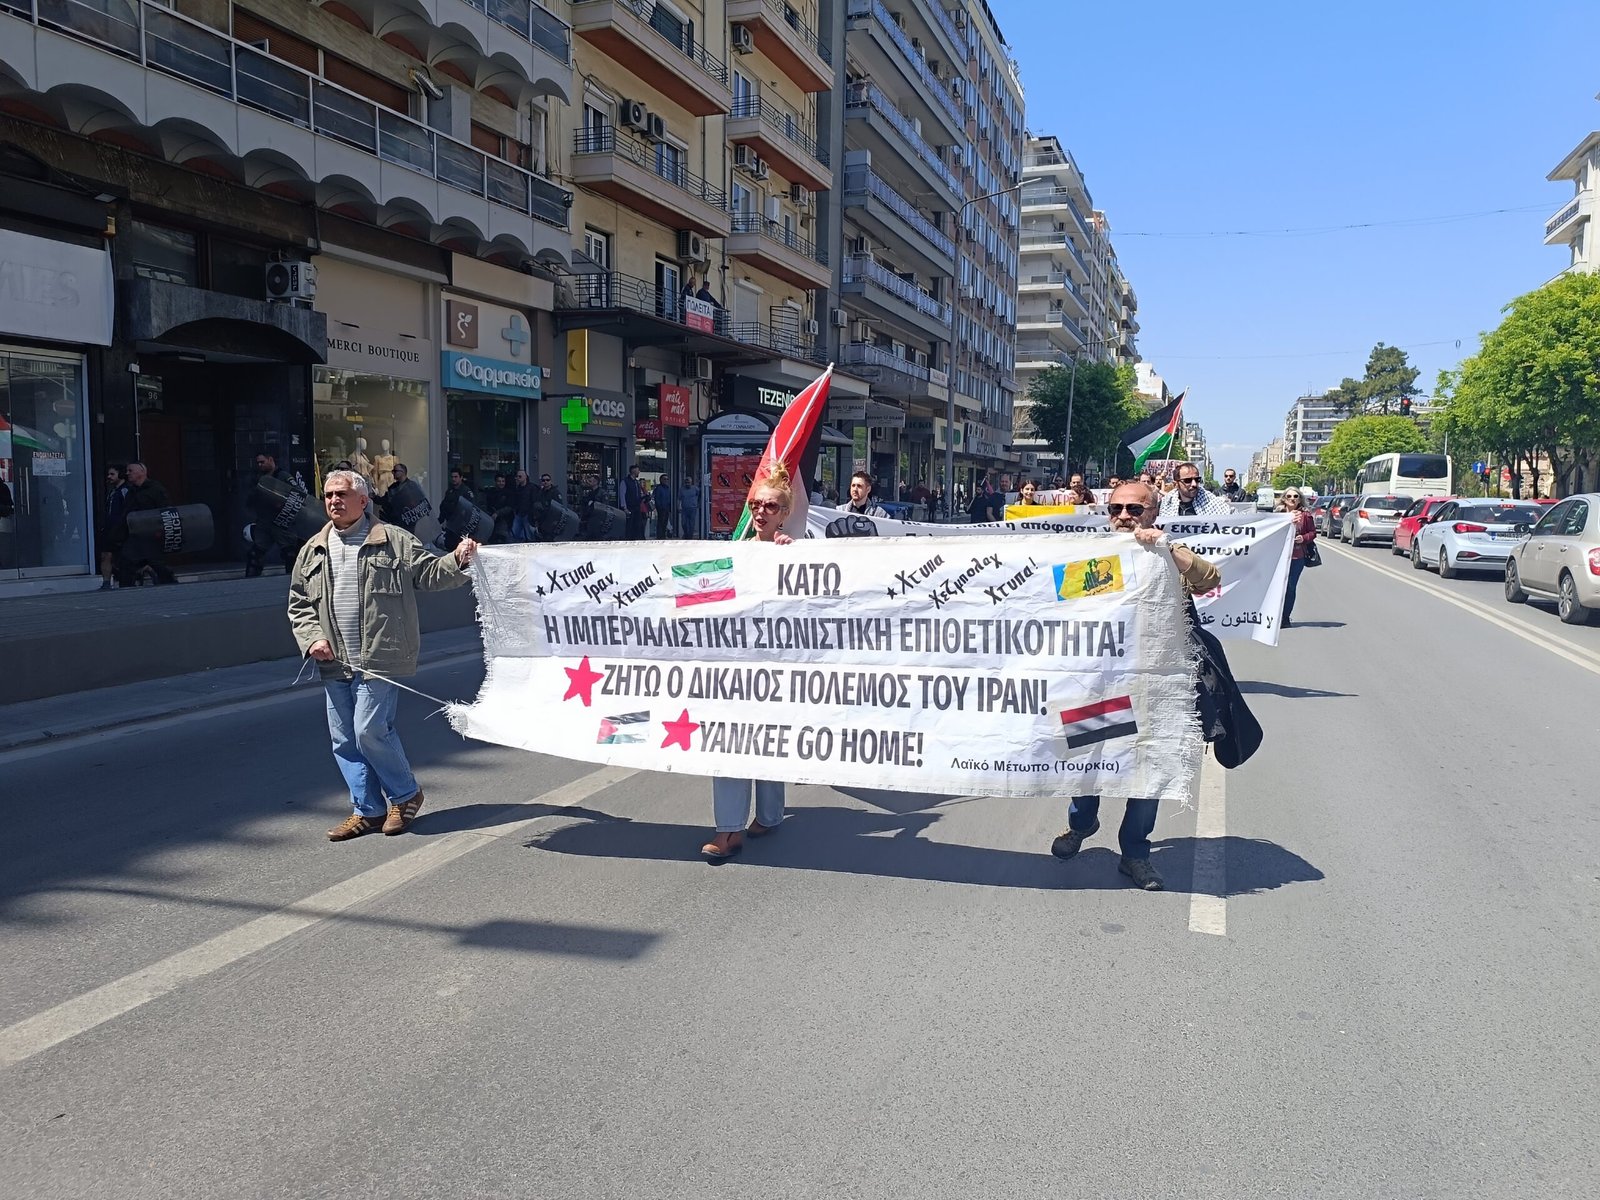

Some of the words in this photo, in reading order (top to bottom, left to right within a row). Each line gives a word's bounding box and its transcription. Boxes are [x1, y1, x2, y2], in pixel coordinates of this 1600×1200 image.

[327, 338, 362, 353] MERCI
[368, 345, 420, 363] BOUTIQUE
[455, 357, 540, 389] Φαρμακείο
[148, 391, 158, 400] 96
[542, 427, 551, 436] 96
[281, 496, 305, 528] POLICE
[170, 511, 182, 550] POLICE
[1020, 520, 1098, 534] απόφαση
[1170, 522, 1256, 538] εκτέλεση
[546, 561, 596, 594] Χτυπα
[777, 562, 842, 596] ΚΑΤΩ
[894, 554, 946, 595] Χτυπα
[1221, 612, 1262, 627] لقانون
[543, 615, 561, 644] Η
[563, 615, 748, 649] ΙΜΠΕΡΙΑΛΙΣΤΙΚΗ
[752, 617, 892, 651] ΣΙΩΝΙΣΤΙΚΗ
[900, 617, 1126, 658] ΕΠΙΘΕΤΙΚΟΤΗΤΑ!
[601, 664, 662, 697] ΖΗΤΩ
[667, 665, 684, 698] Ο
[687, 666, 784, 702] ΔΙΚΑΙΟΣ
[789, 669, 912, 709] ΠΟΛΕΜΟΣ
[917, 674, 970, 711] ΤΟΥ
[977, 677, 1048, 716] ΙΡΑΝ!
[699, 720, 792, 758] YANKEE
[797, 725, 834, 762] GO
[840, 728, 924, 768] HOME!
[950, 757, 990, 772] Λαϊκό
[993, 760, 1050, 772] Μέτωπο
[1054, 760, 1120, 774] (Τουρκία)
